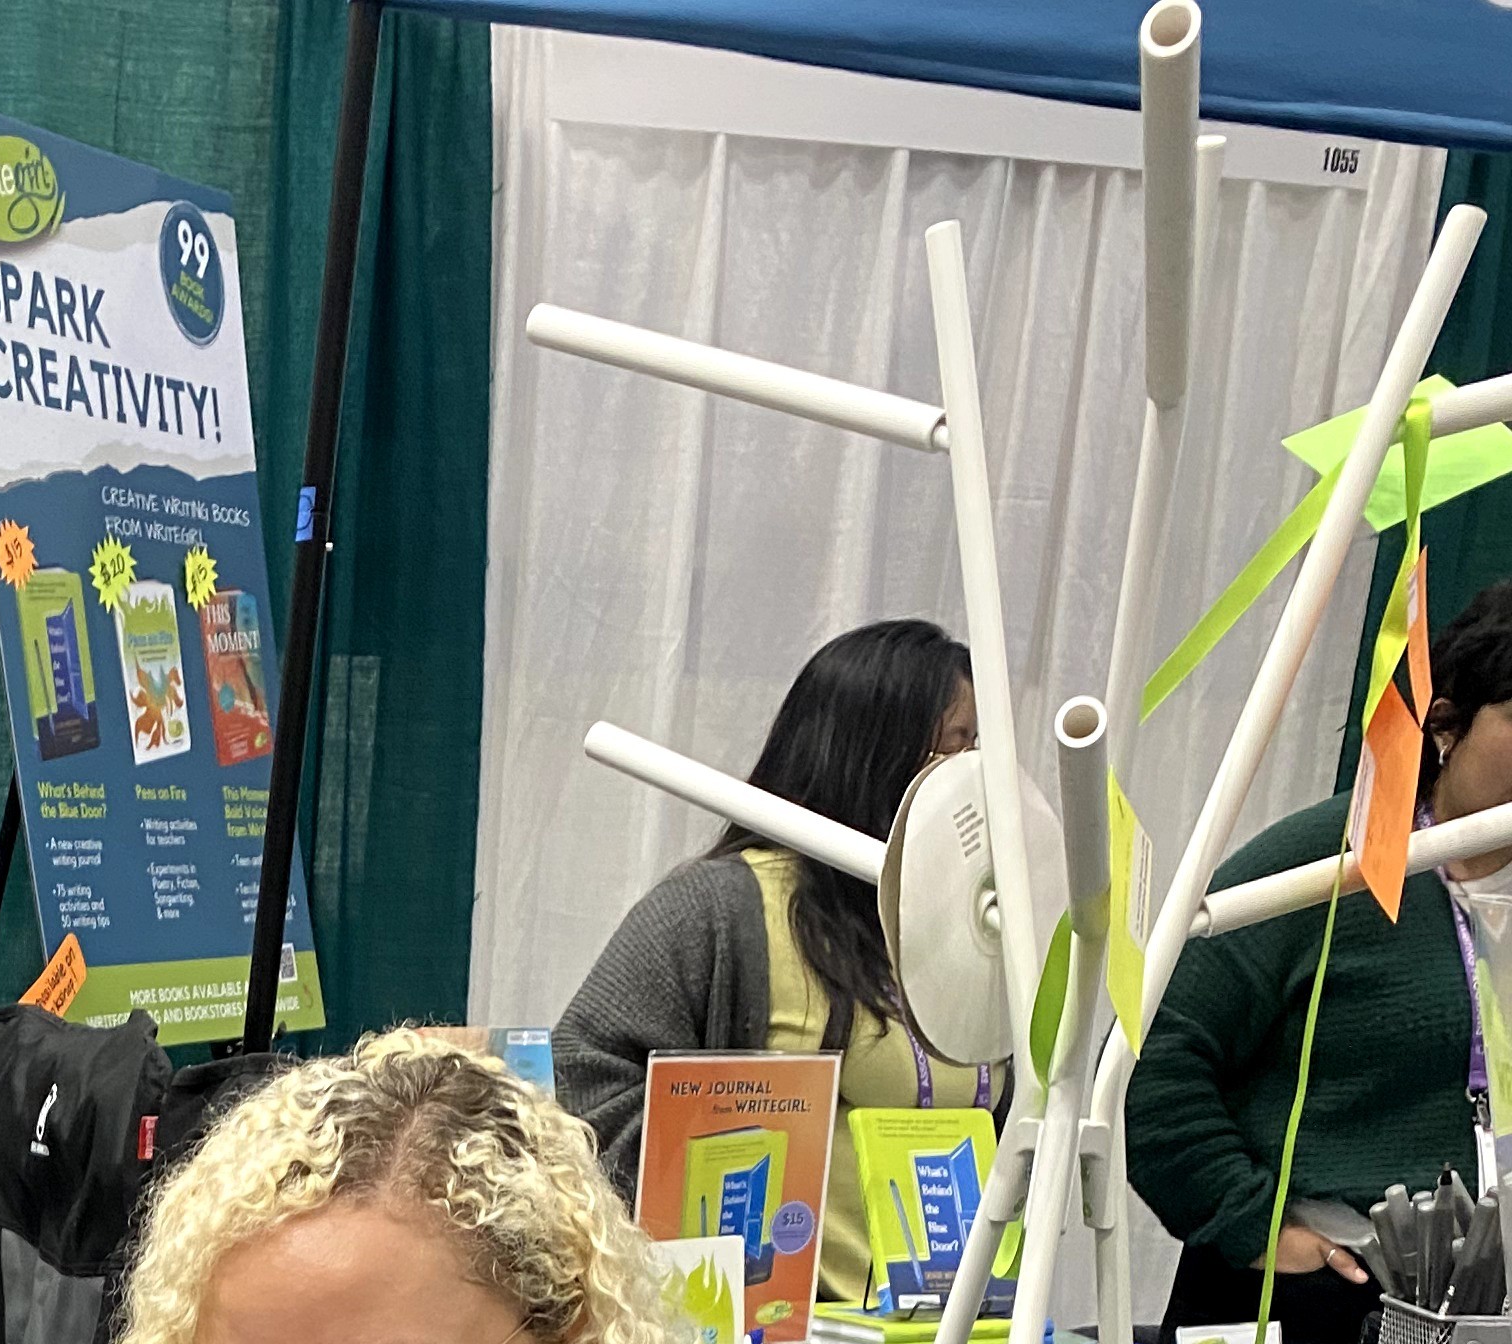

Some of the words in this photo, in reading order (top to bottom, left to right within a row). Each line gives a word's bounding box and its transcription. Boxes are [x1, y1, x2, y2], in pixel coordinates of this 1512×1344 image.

[1322, 146, 1361, 174] 1055
[177, 219, 209, 279] 99
[101, 486, 159, 513] CREATIVE
[163, 496, 208, 521] WRITING
[212, 503, 250, 527] BOOKS
[105, 516, 142, 538] FROM
[100, 553, 125, 587] $20
[129, 989, 160, 1005] MORE
[160, 986, 190, 1002] BOOKS
[192, 981, 242, 1000] AVAILABLE
[164, 1008, 184, 1024] AND
[184, 1001, 243, 1022] BOOKSTORES
[670, 1081, 702, 1096] NEW
[706, 1080, 773, 1095] JOURNAL
[735, 1099, 811, 1113] WRITEGIRL:
[917, 1165, 949, 1178] What's
[921, 1183, 953, 1197] Behind
[924, 1203, 940, 1215] the
[782, 1212, 804, 1226] $15
[927, 1220, 949, 1234] Blue
